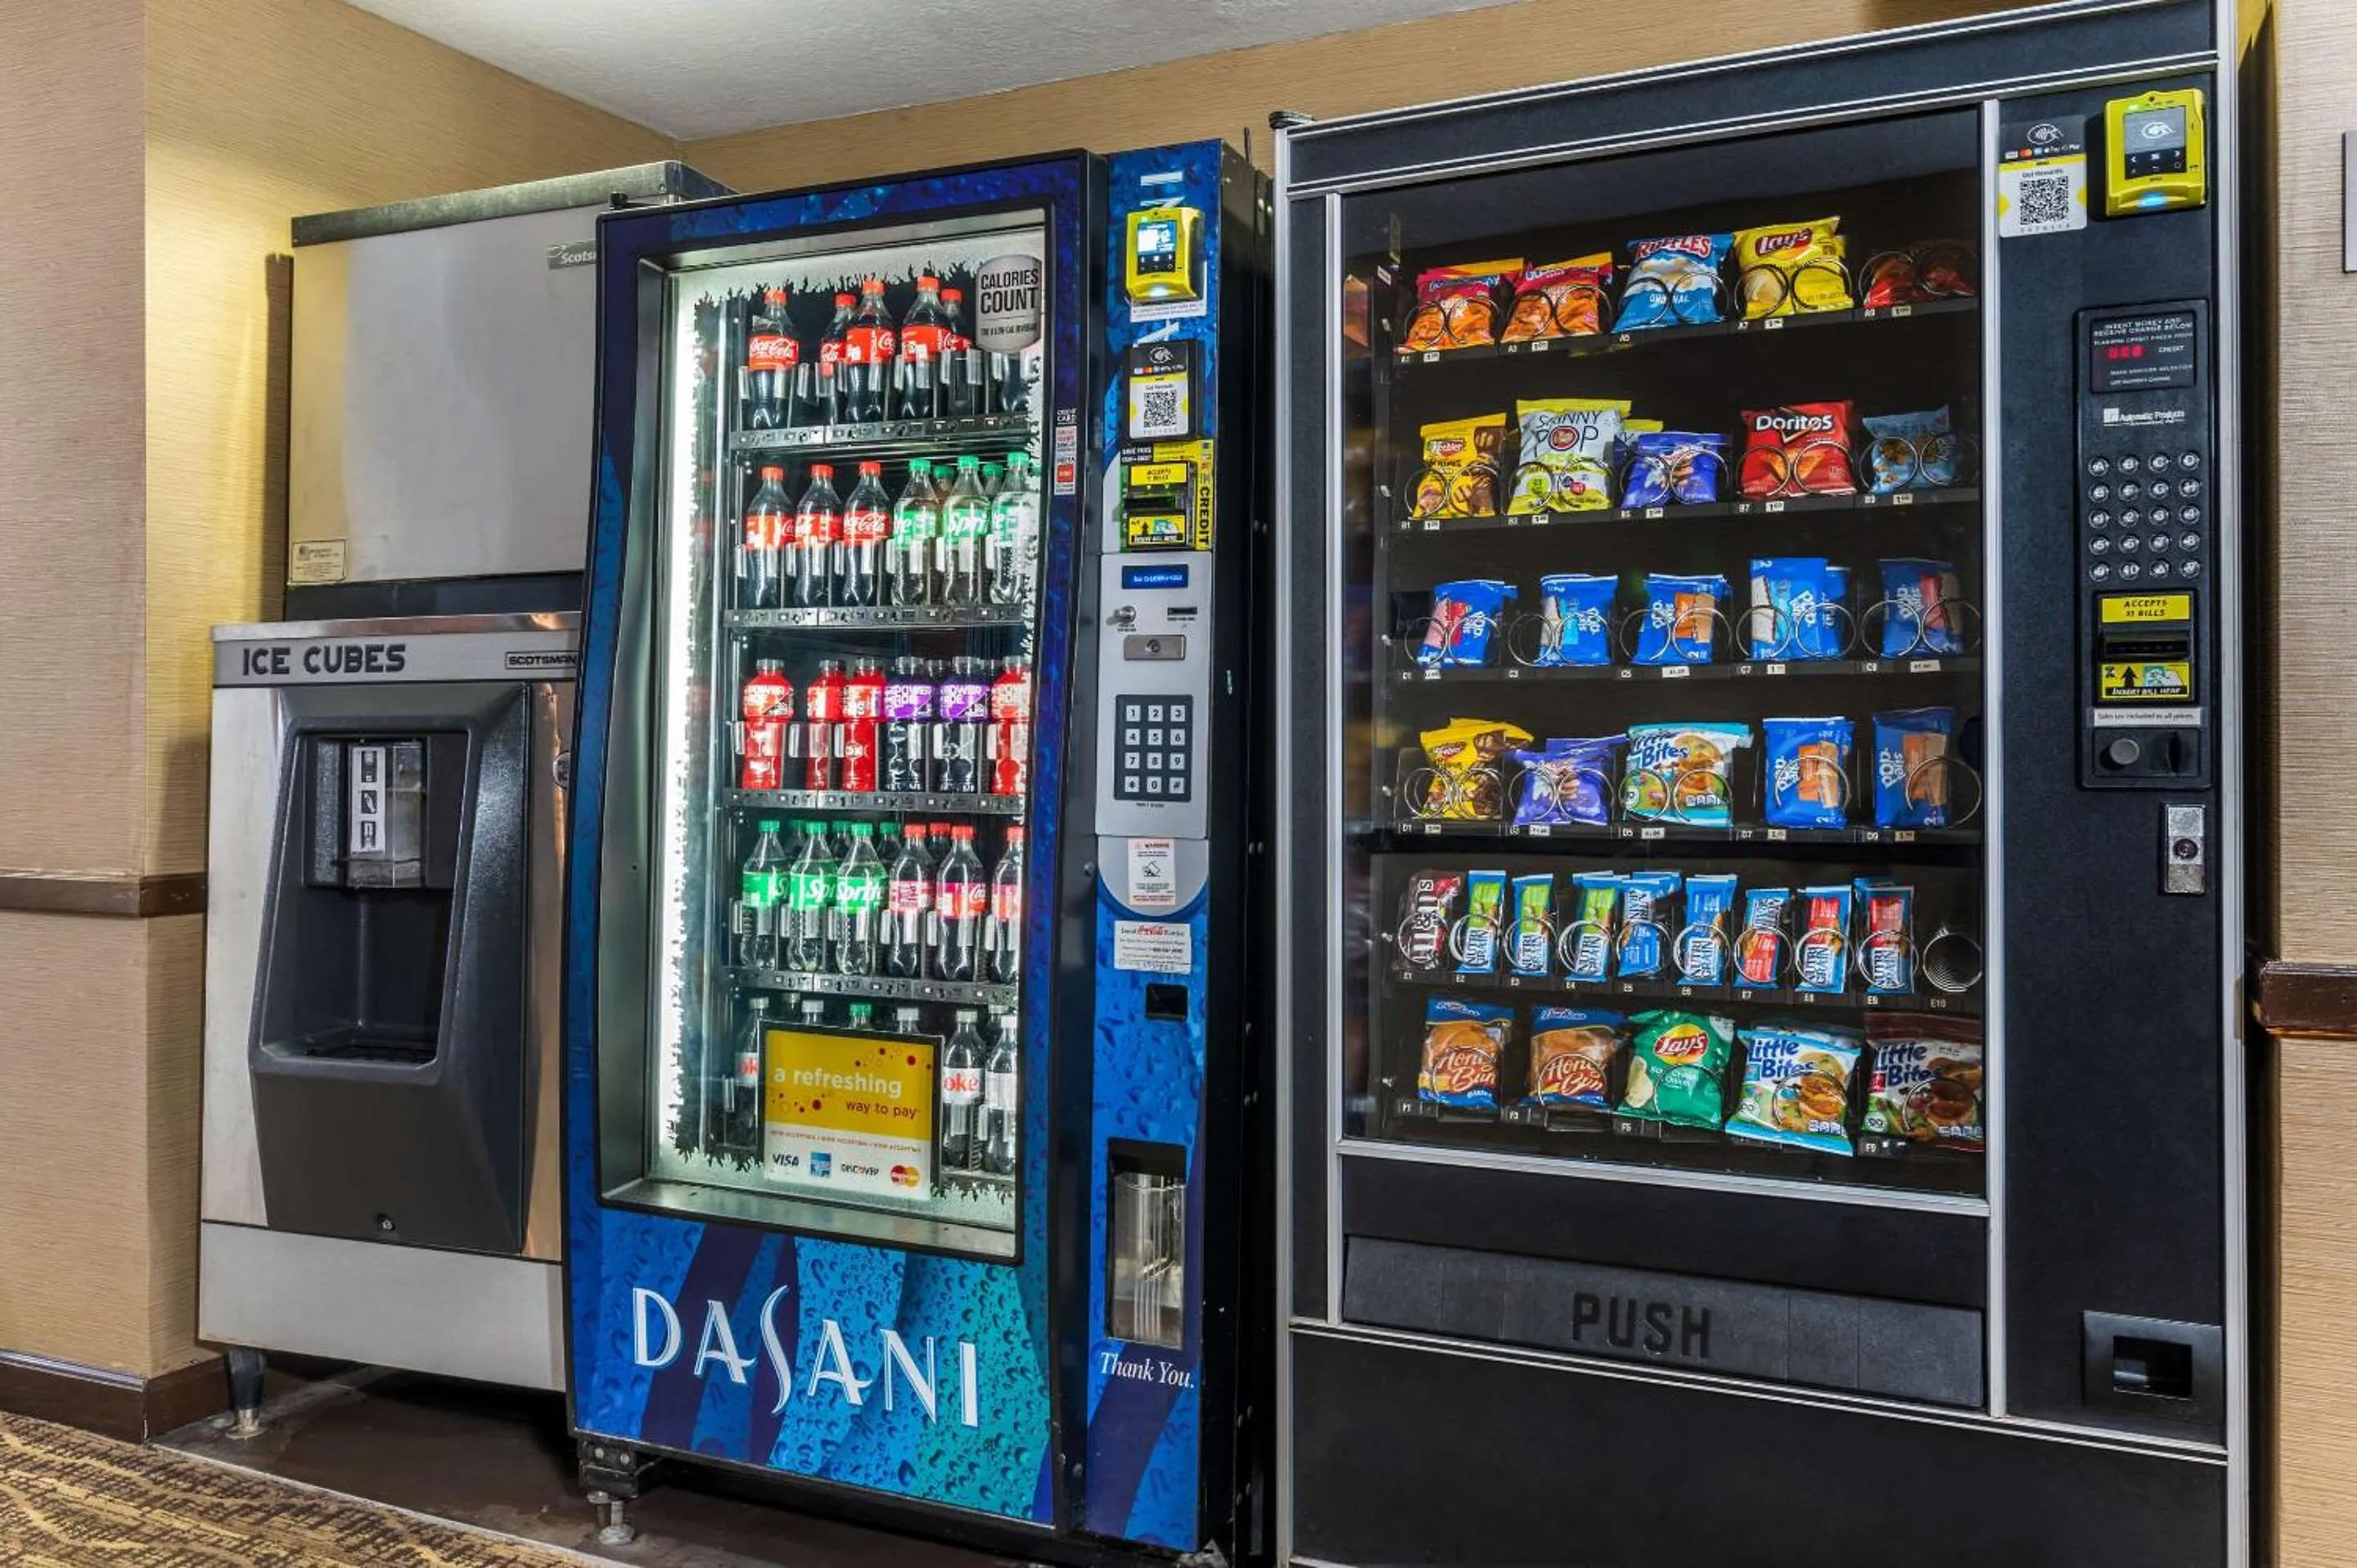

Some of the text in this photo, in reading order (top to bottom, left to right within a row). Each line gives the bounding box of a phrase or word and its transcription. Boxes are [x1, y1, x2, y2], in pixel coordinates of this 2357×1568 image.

[561, 250, 596, 264] Scots
[980, 268, 1039, 290] CALORIES
[980, 287, 1039, 314] COUNT
[1755, 414, 1834, 431] Doritos
[1535, 425, 1599, 457] POP
[1199, 486, 1210, 544] CREDIT
[243, 643, 406, 676] ICE CUBES
[508, 656, 577, 665] SCOTSMAN
[1130, 709, 1181, 718] 1 2 3
[1129, 732, 1181, 742] 4 5 6
[1151, 757, 1158, 765] 8
[1174, 757, 1181, 765] 9
[1642, 743, 1690, 768] Bites
[1151, 781, 1157, 789] 0
[1657, 1034, 1706, 1057] Lay's
[1749, 1038, 1800, 1062] Little
[1873, 1043, 1927, 1071] Little
[1450, 1066, 1495, 1093] Bun
[1760, 1058, 1816, 1078] Bites
[774, 1066, 903, 1099] a refreshing
[944, 1073, 979, 1092] oke
[1559, 1073, 1604, 1097] Bun
[846, 1102, 917, 1120] way to pay
[773, 1154, 800, 1167] VISA
[840, 1163, 880, 1176] DISCOVER
[1571, 1291, 1710, 1359] PUSH
[632, 1284, 979, 1428] DASANI
[1101, 1351, 1194, 1389] Thank You.
